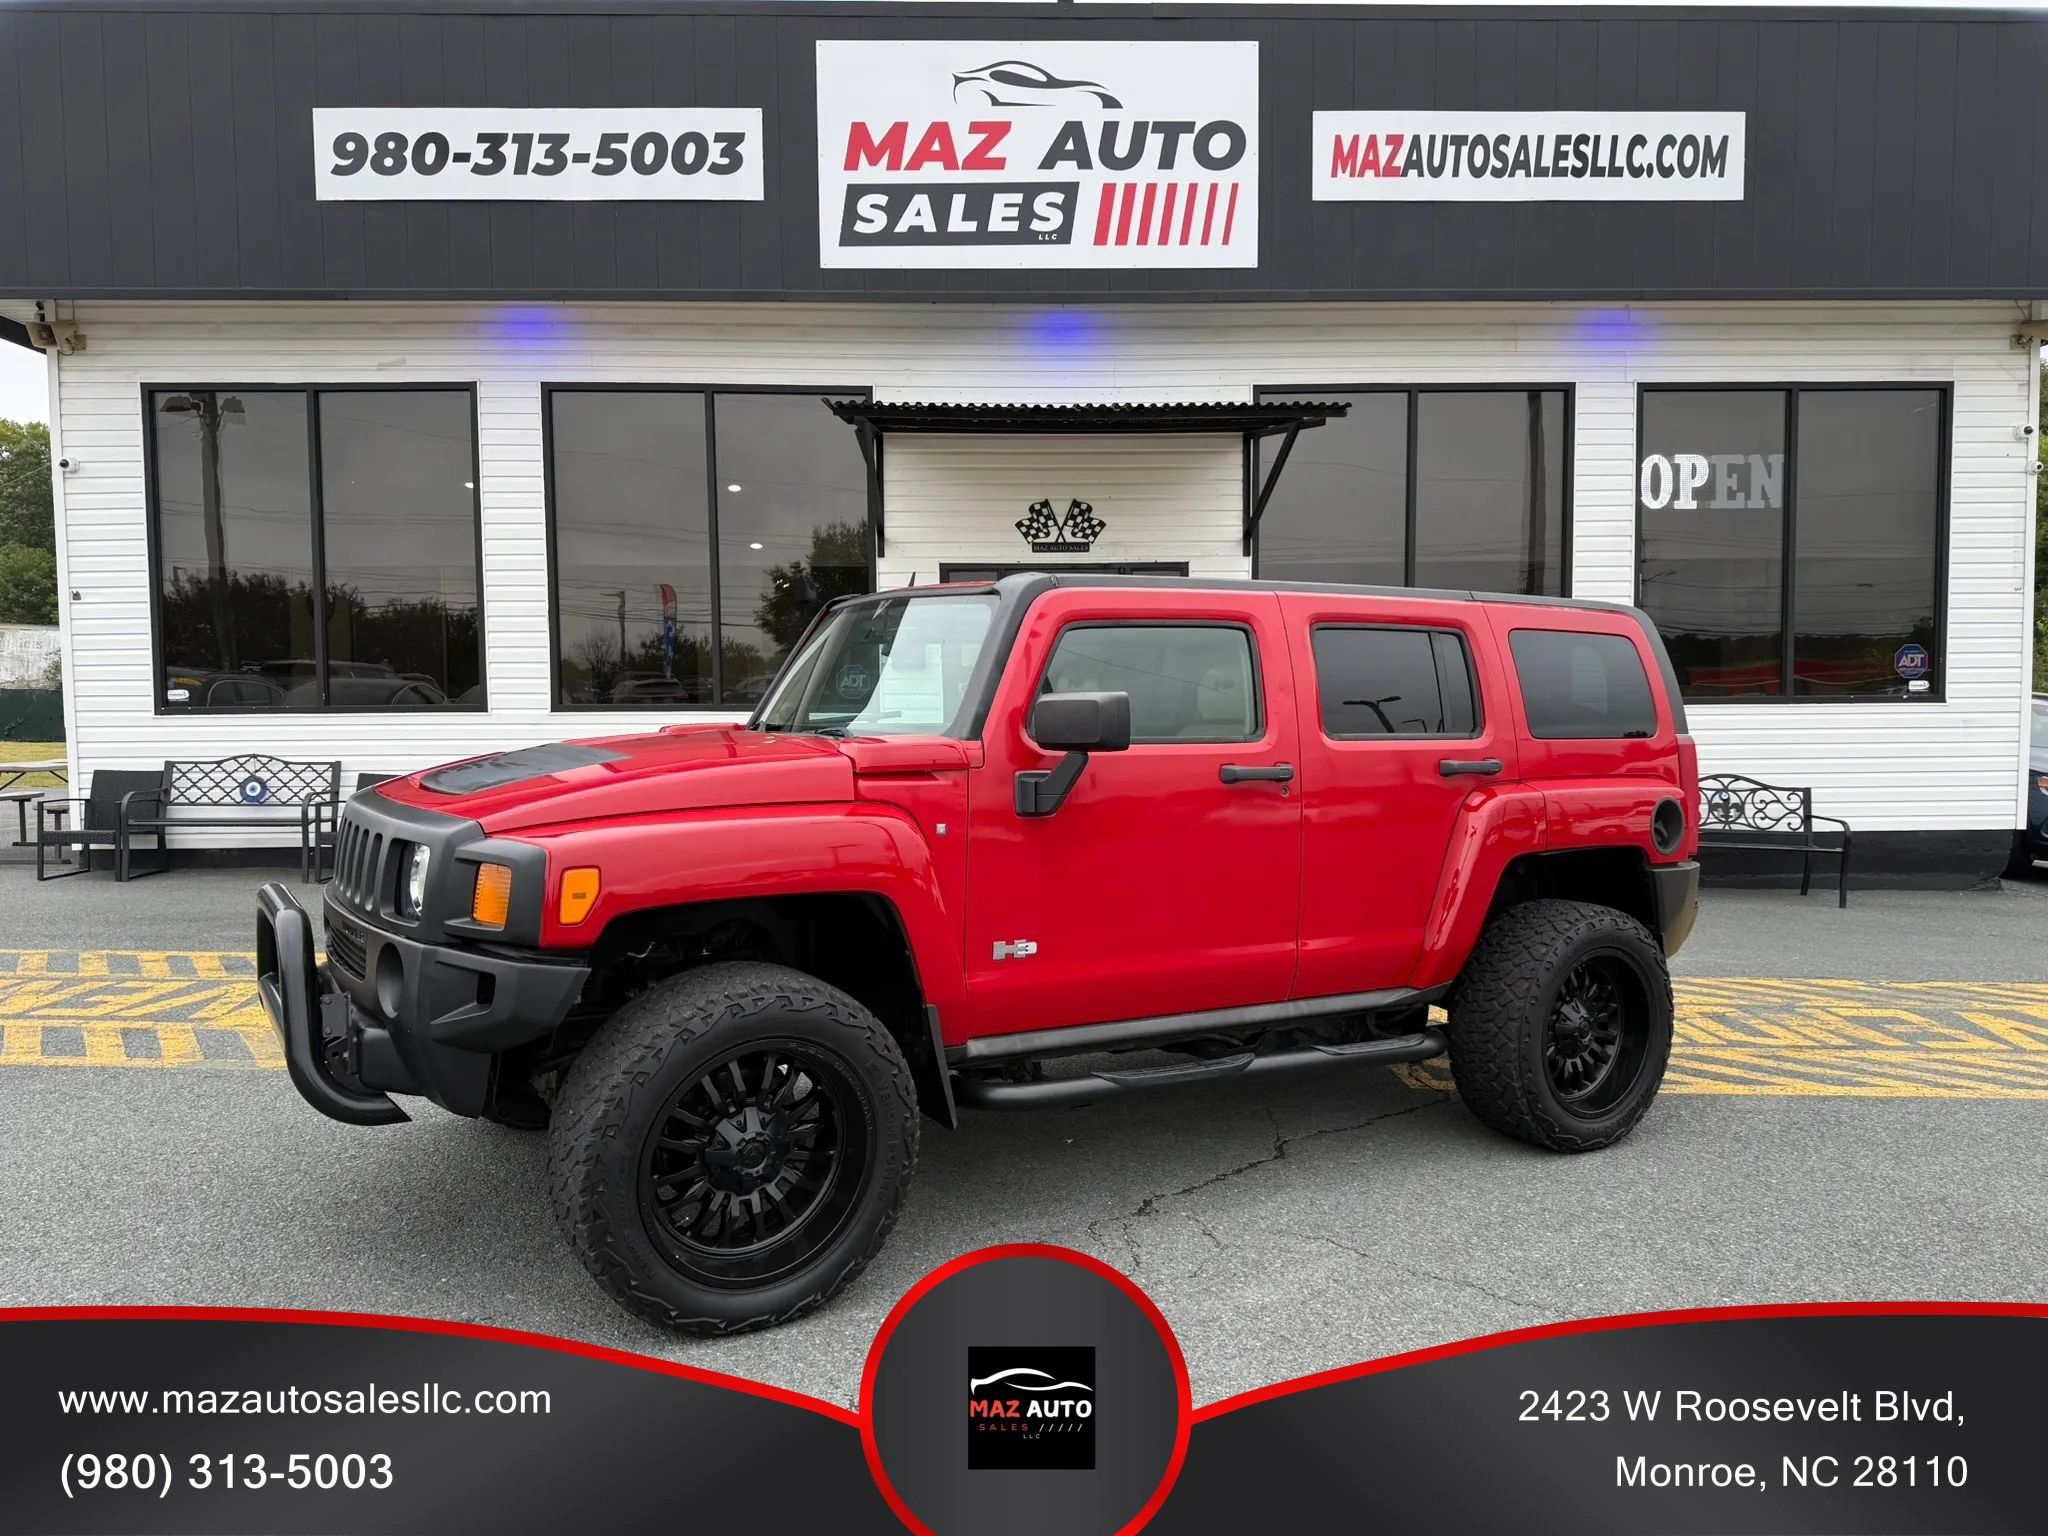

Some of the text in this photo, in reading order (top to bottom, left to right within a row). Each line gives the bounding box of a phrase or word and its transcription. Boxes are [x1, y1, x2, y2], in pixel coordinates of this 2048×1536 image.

[330, 131, 746, 177] 980-313-5003
[843, 120, 1247, 171] MAZ AUTO
[1331, 134, 1729, 179] MAZAUTOSALESLLC.COM
[853, 191, 1066, 233] SALES
[1038, 233, 1058, 241] LLC
[1640, 453, 1784, 510] OPEN
[840, 674, 867, 688] ADT
[1898, 653, 1926, 667] ADT
[992, 939, 1038, 960] H3
